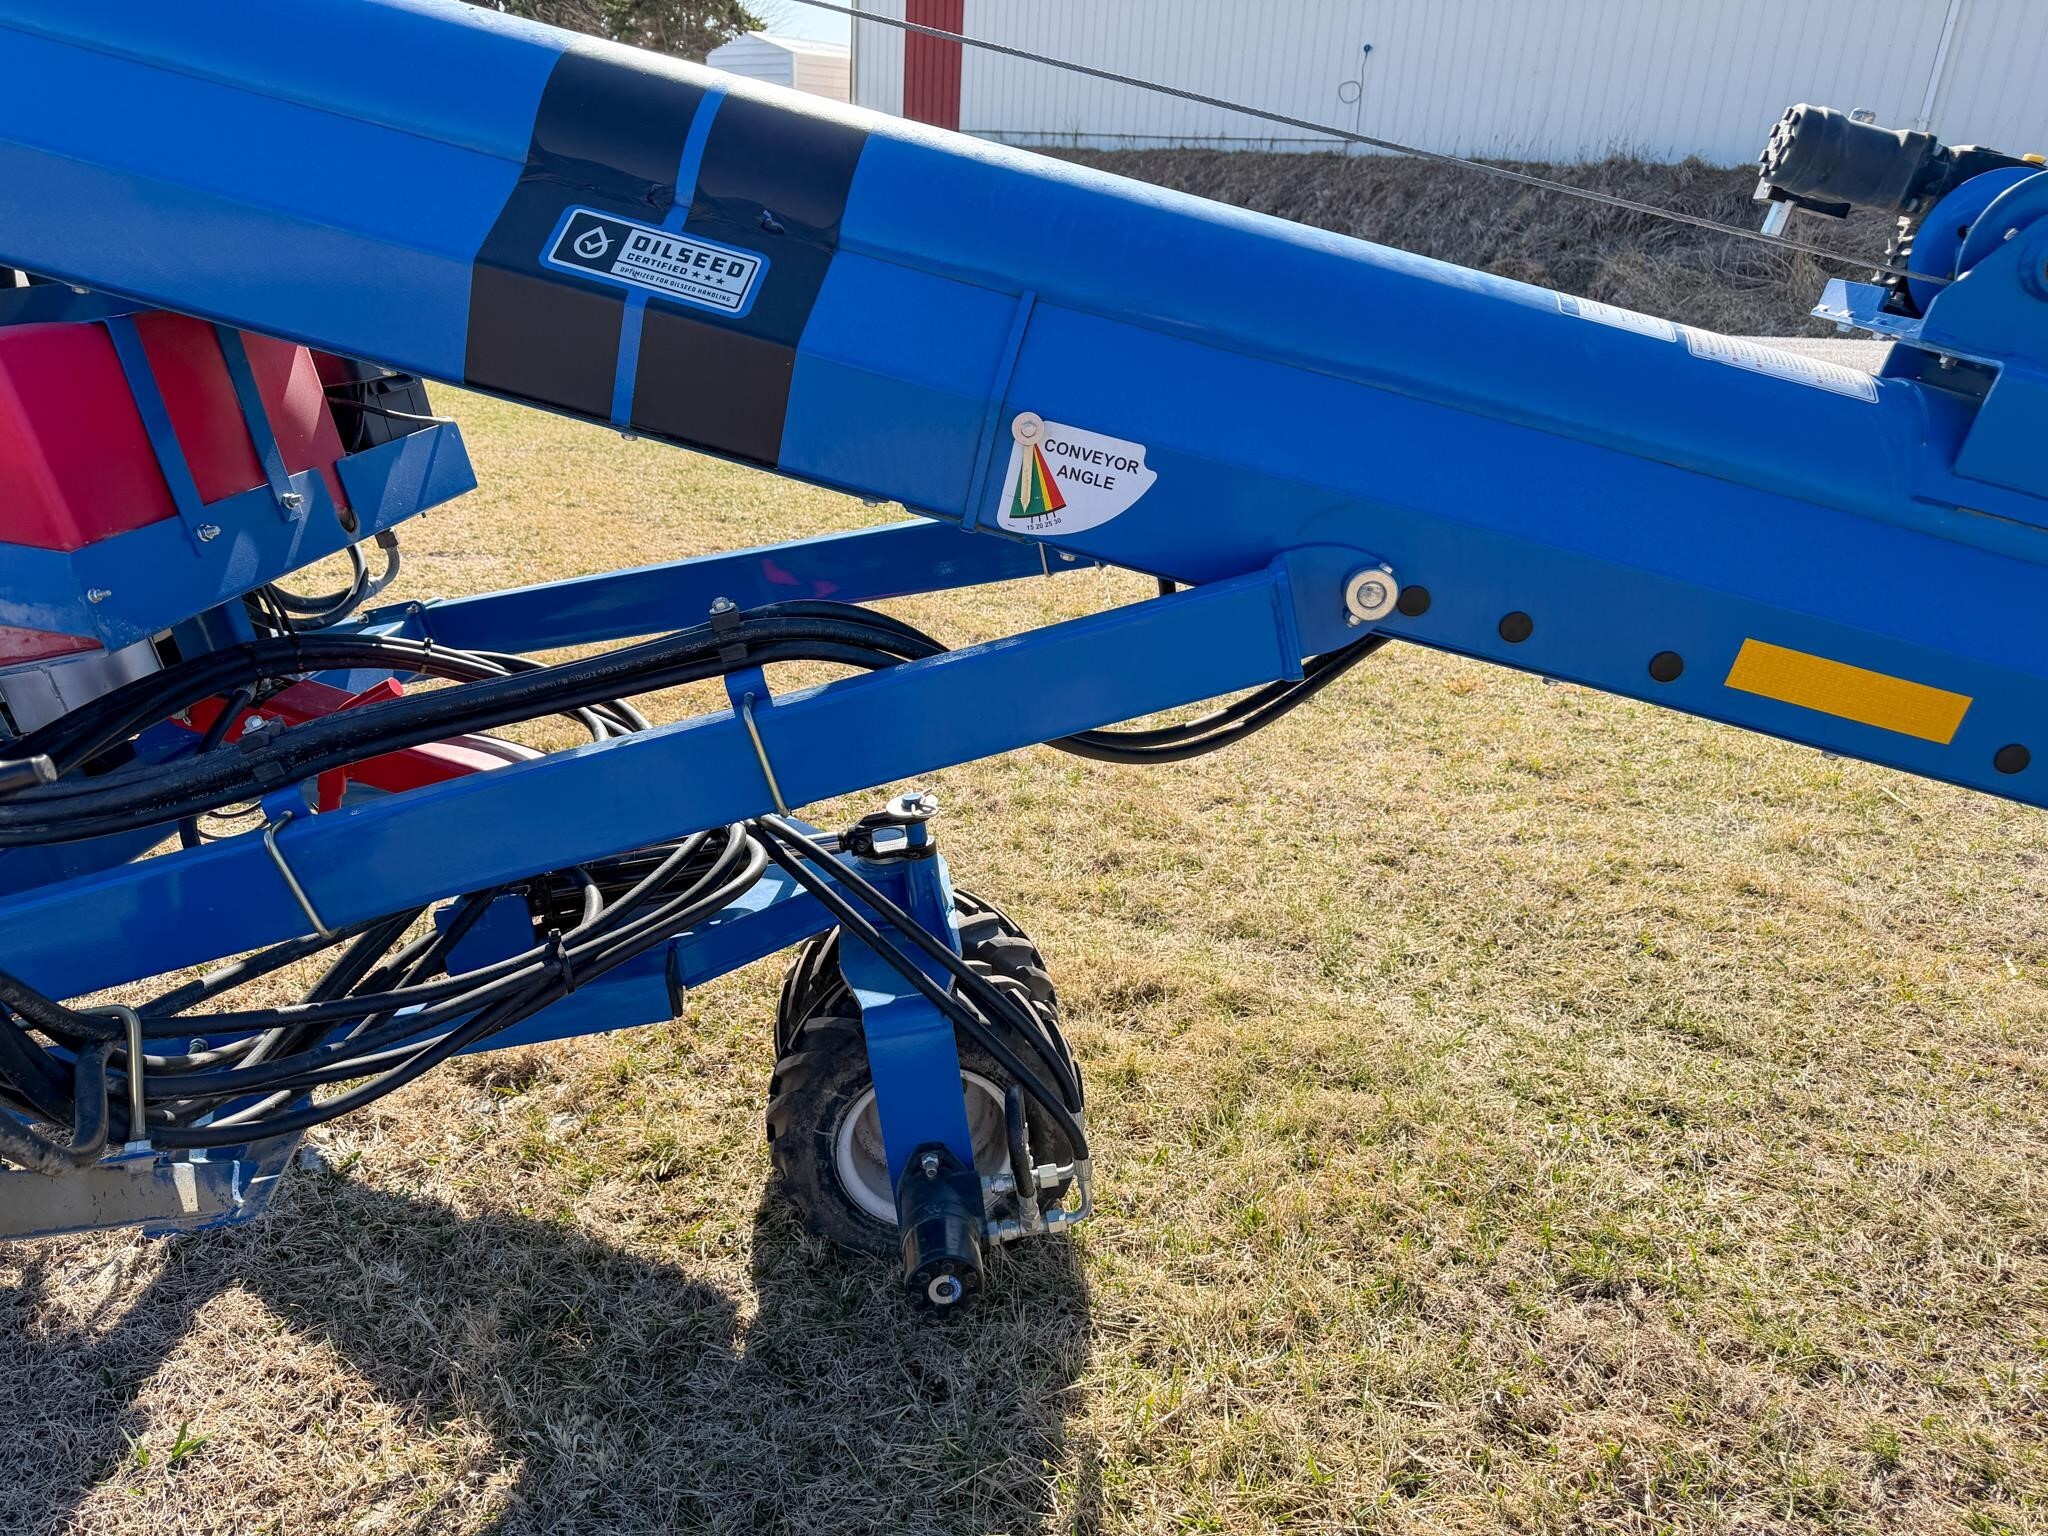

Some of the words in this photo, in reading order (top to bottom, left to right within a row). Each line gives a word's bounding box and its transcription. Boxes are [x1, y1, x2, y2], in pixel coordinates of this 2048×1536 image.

[627, 253, 687, 275] CERTIFIED
[632, 235, 745, 278] OILSEED
[620, 267, 654, 280] OPTIMIZED
[656, 276, 669, 284] FOR
[670, 279, 697, 293] OILSEED
[698, 286, 731, 302] HANDLING
[1045, 439, 1139, 474] CONVEYOR
[1056, 465, 1115, 490] ANGLE
[1053, 517, 1062, 525] 30
